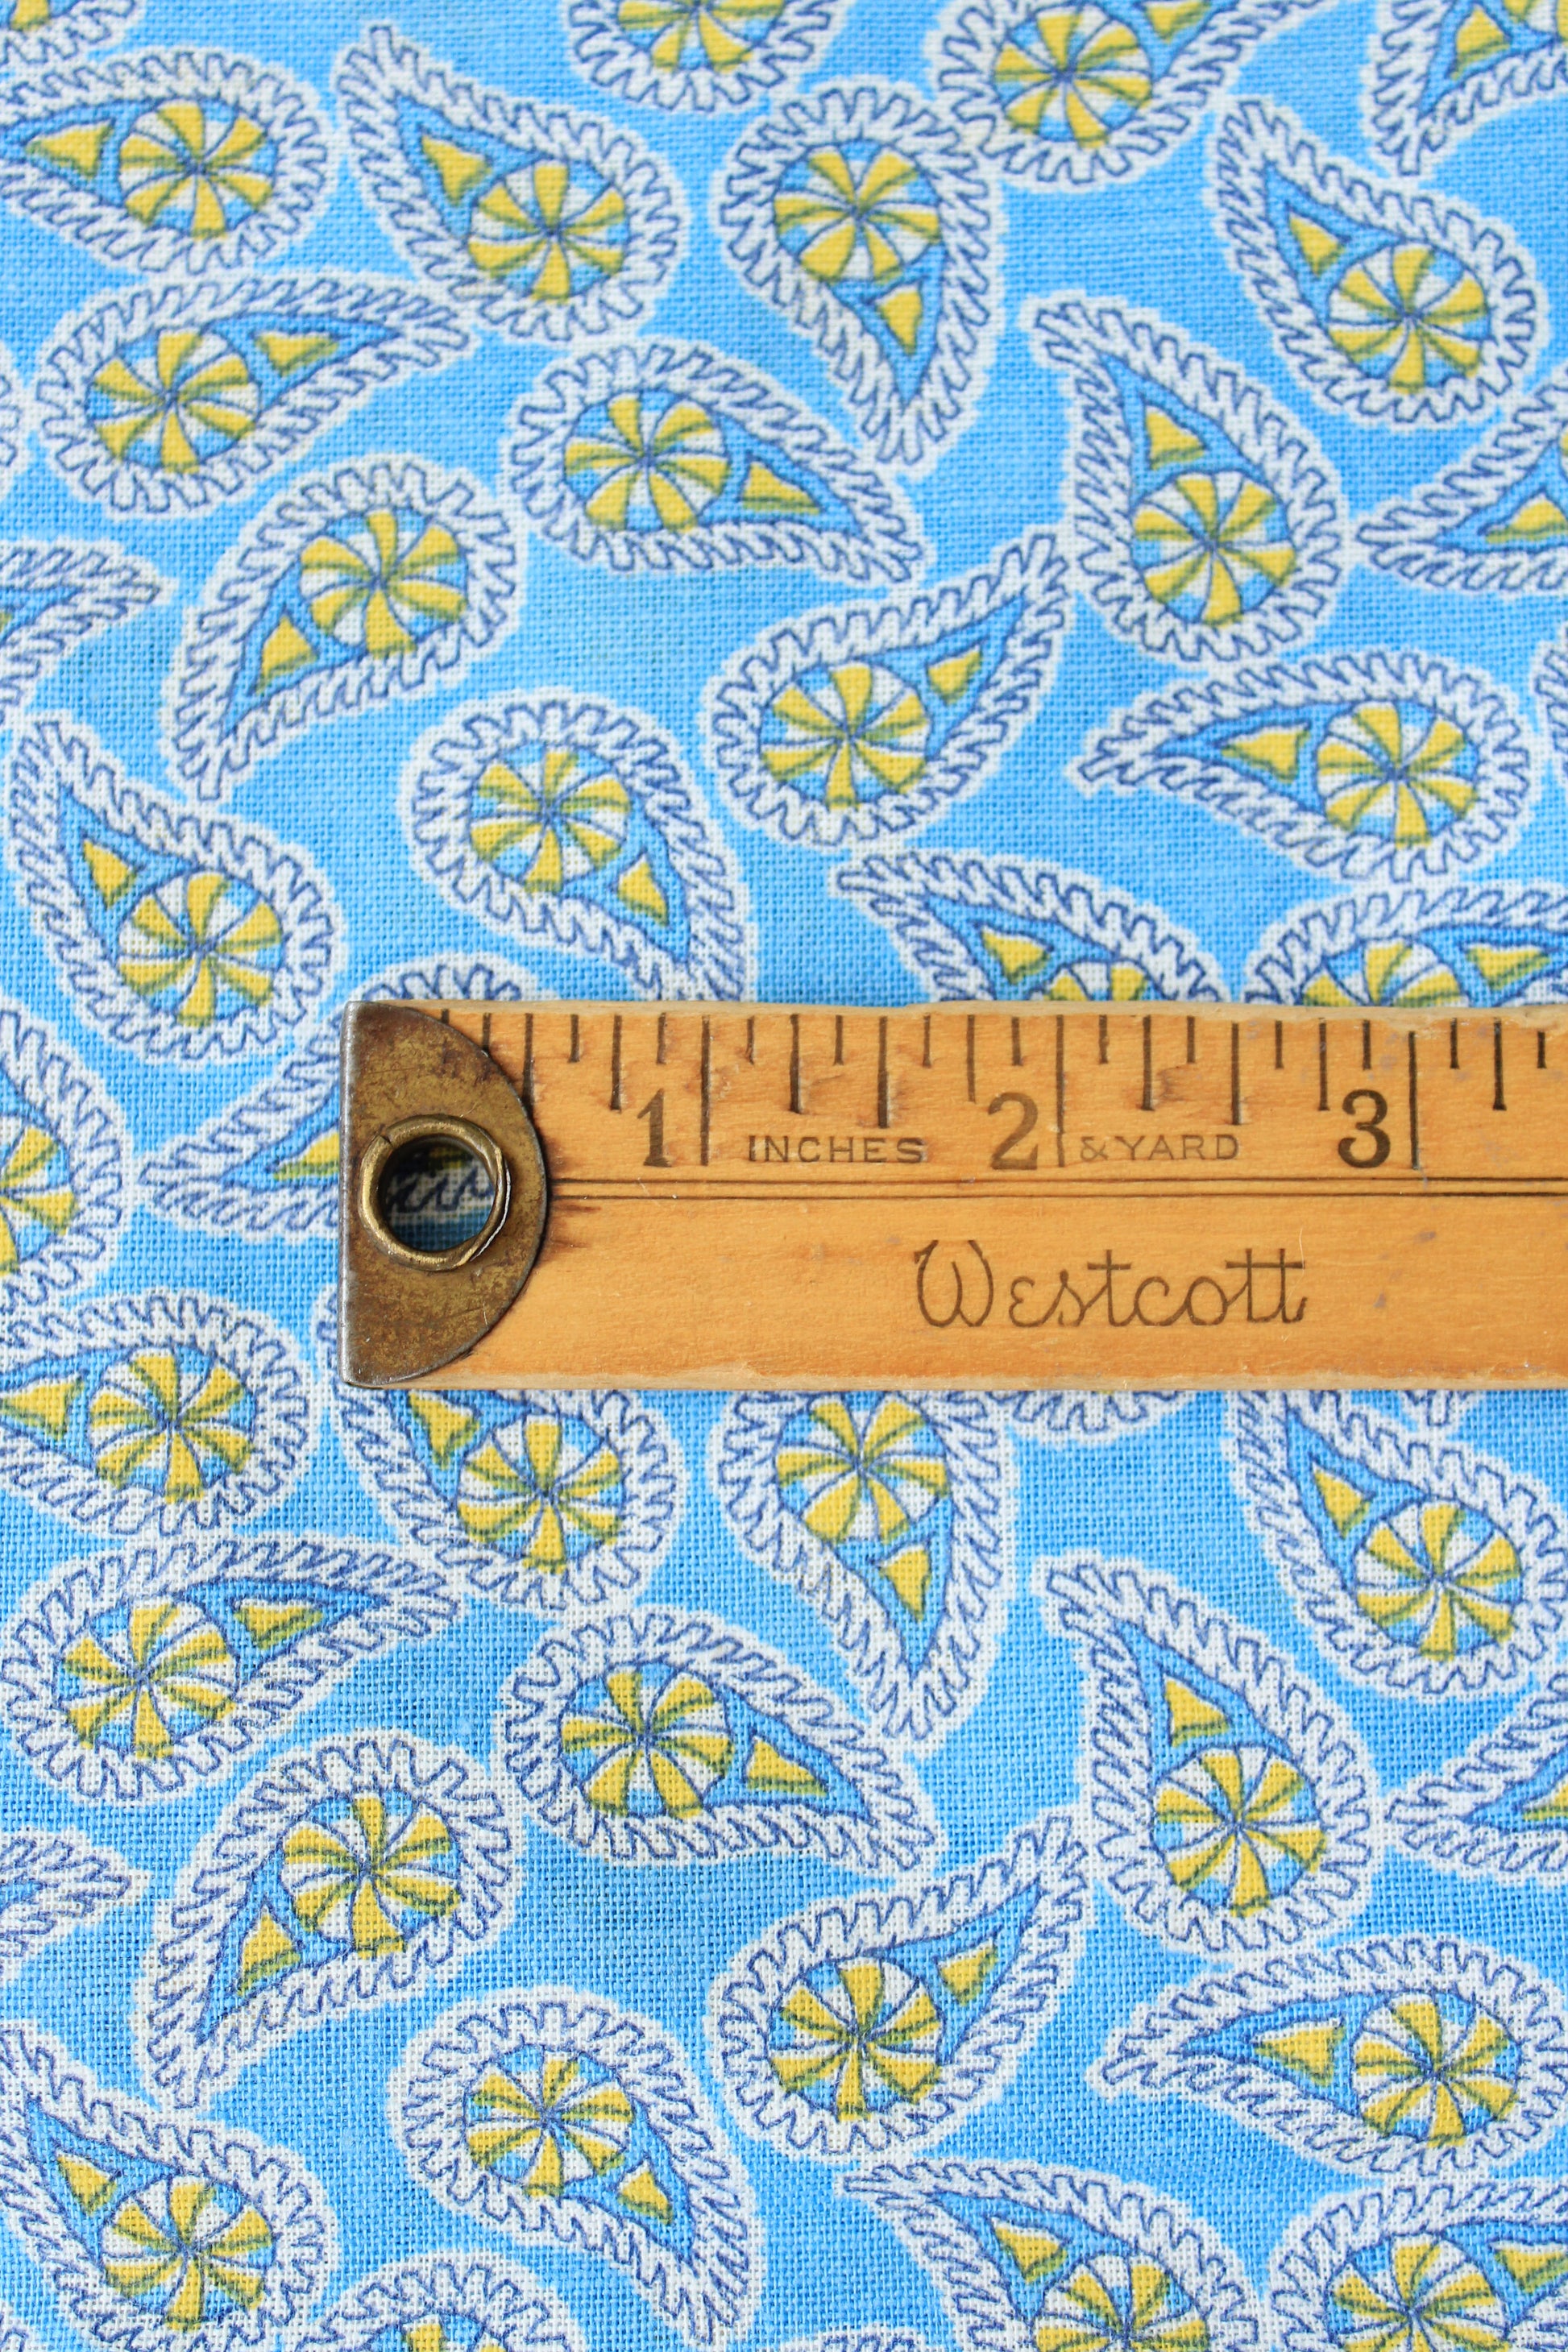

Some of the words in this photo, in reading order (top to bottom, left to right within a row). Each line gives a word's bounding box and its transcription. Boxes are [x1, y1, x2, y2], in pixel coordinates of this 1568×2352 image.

[637, 1088, 673, 1168] 1
[748, 1135, 925, 1164] INCHES
[987, 1092, 1039, 1171] 2
[1338, 1089, 1391, 1169] 3
[913, 1239, 1308, 1329] Westcott
